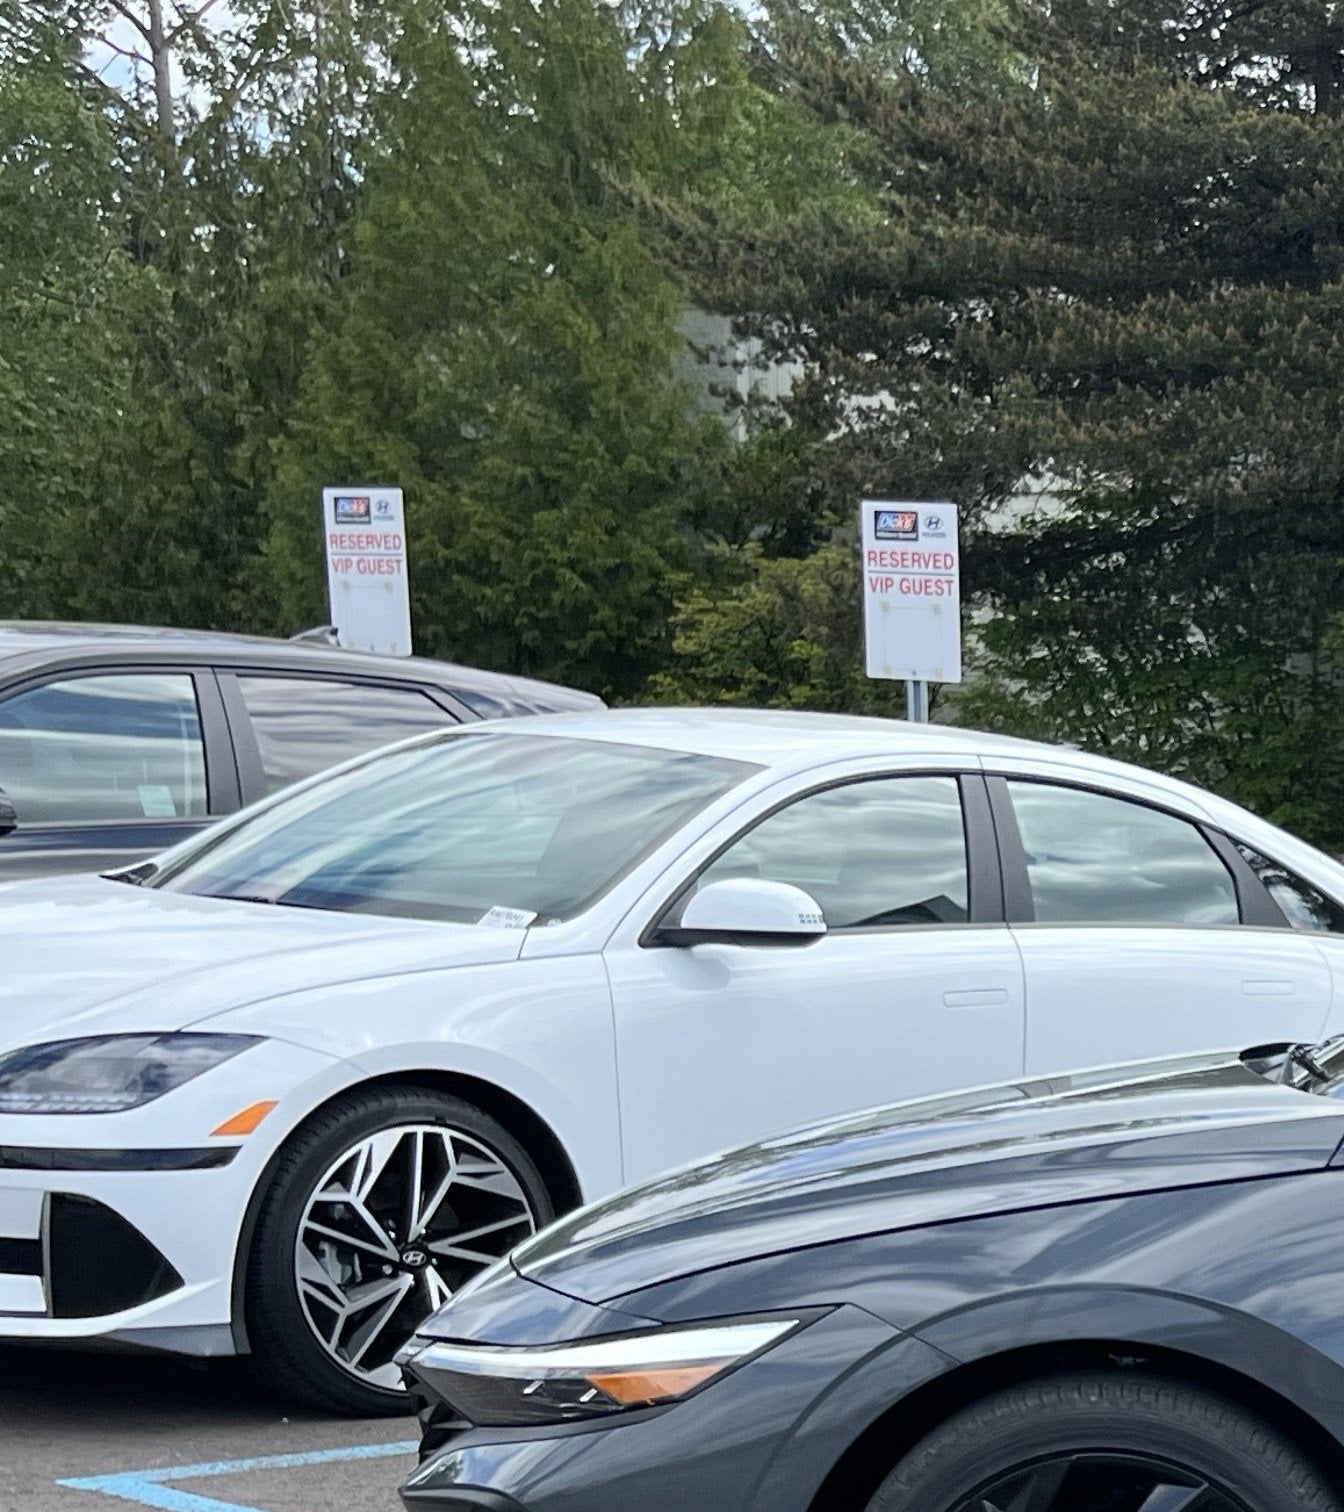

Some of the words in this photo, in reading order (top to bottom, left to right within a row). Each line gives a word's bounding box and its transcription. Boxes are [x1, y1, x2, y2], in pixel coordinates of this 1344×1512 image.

[330, 533, 402, 550] RESERVED
[332, 559, 353, 574] VIP
[357, 558, 403, 575] GUEST
[867, 550, 954, 570] RESERVED
[869, 576, 894, 594] VIP
[899, 578, 954, 596] GUEST
